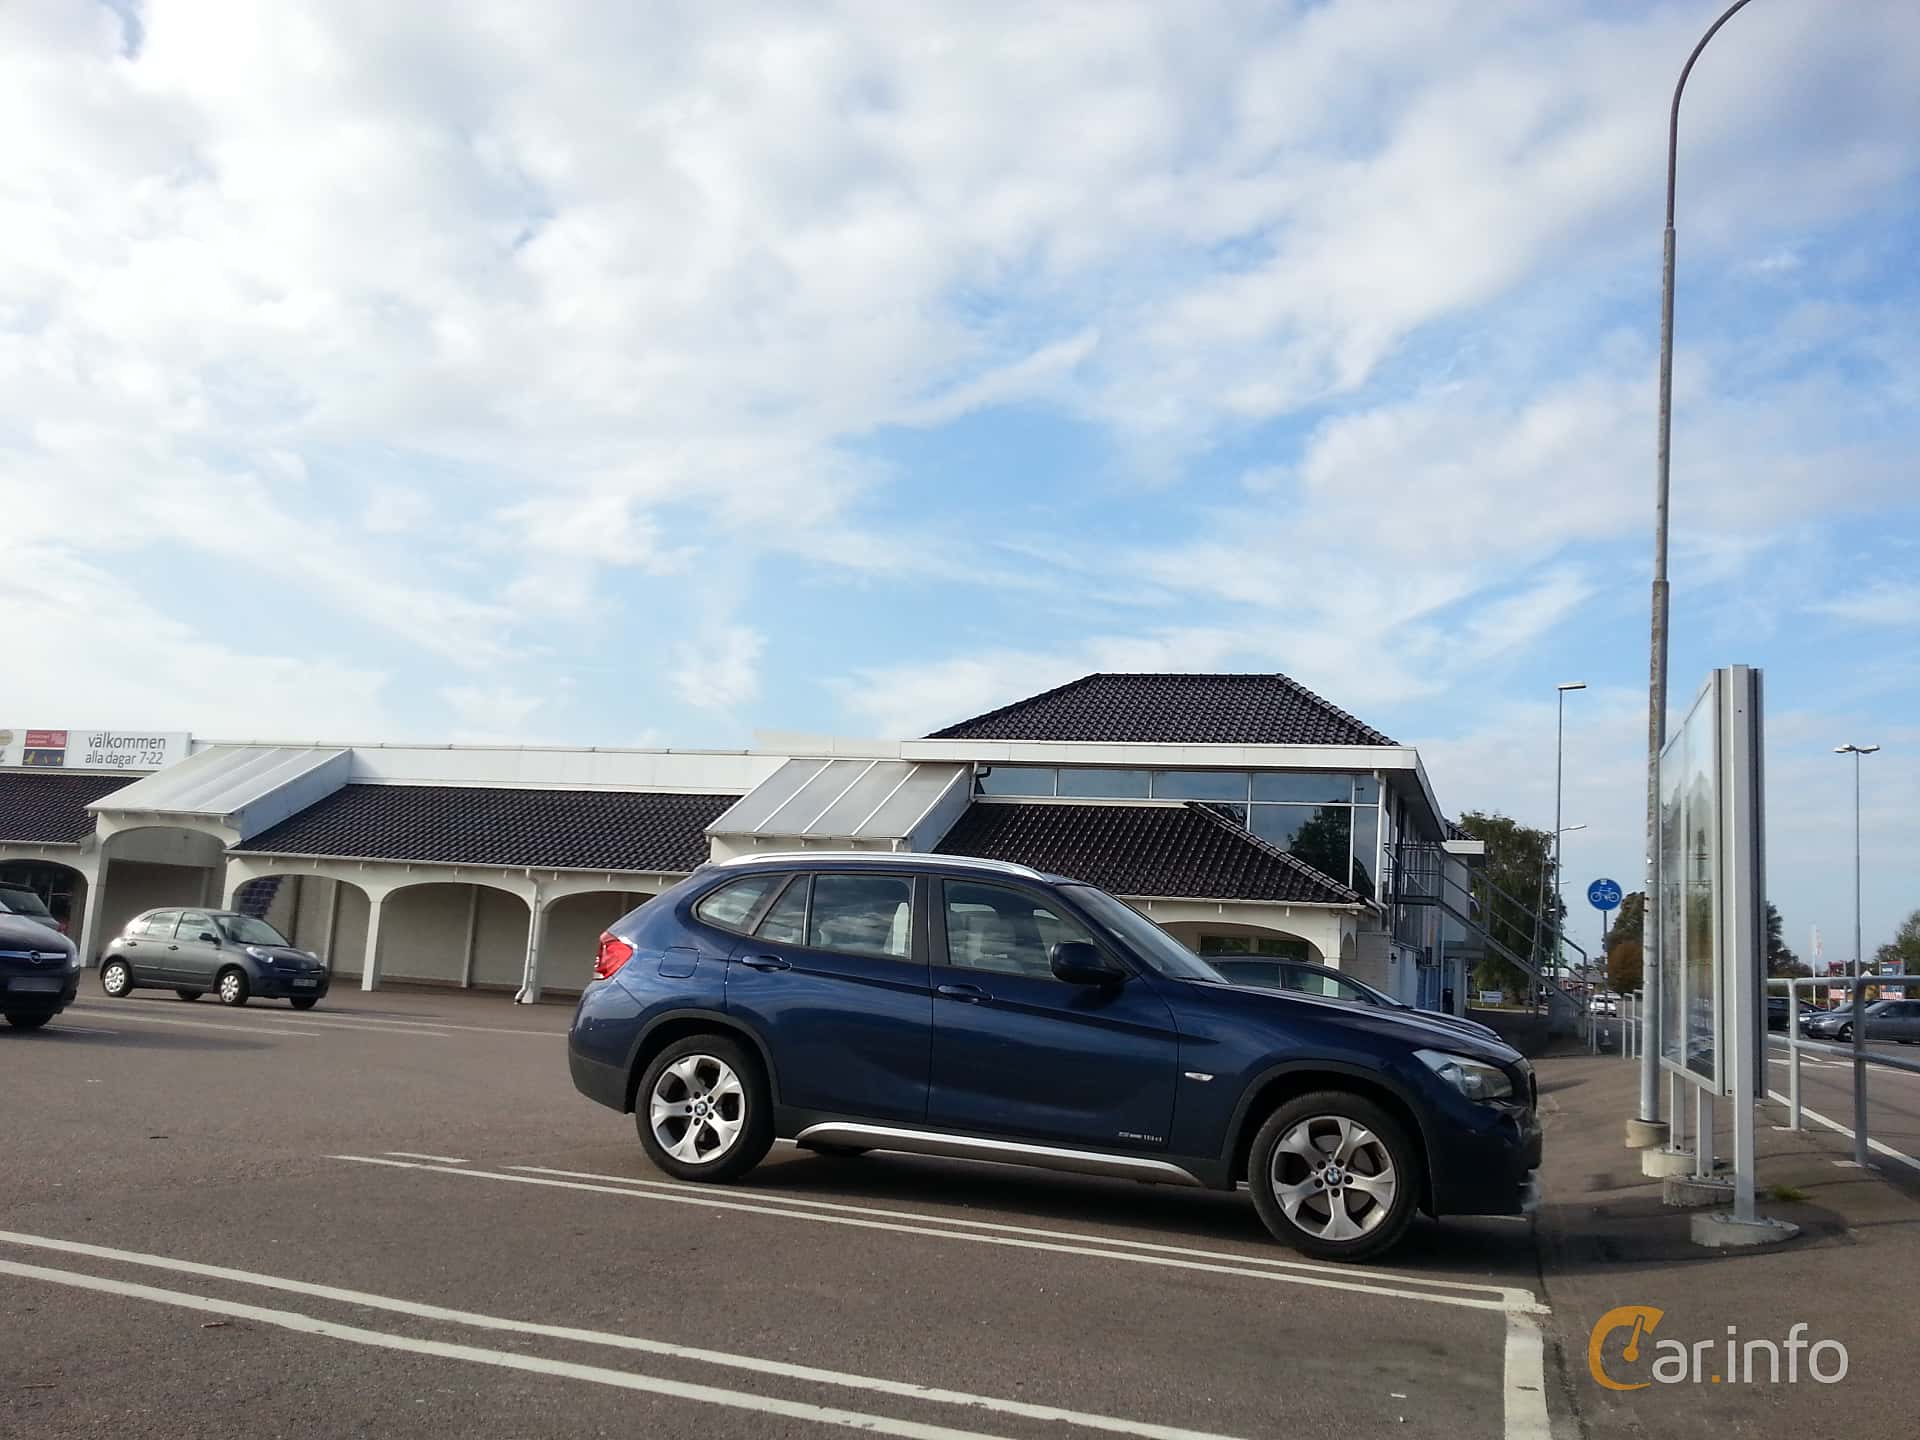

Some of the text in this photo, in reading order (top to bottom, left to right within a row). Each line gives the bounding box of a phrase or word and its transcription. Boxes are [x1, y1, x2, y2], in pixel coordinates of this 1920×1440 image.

[88, 731, 166, 749] välkommen
[85, 750, 104, 764] alla
[105, 751, 137, 768] dagar
